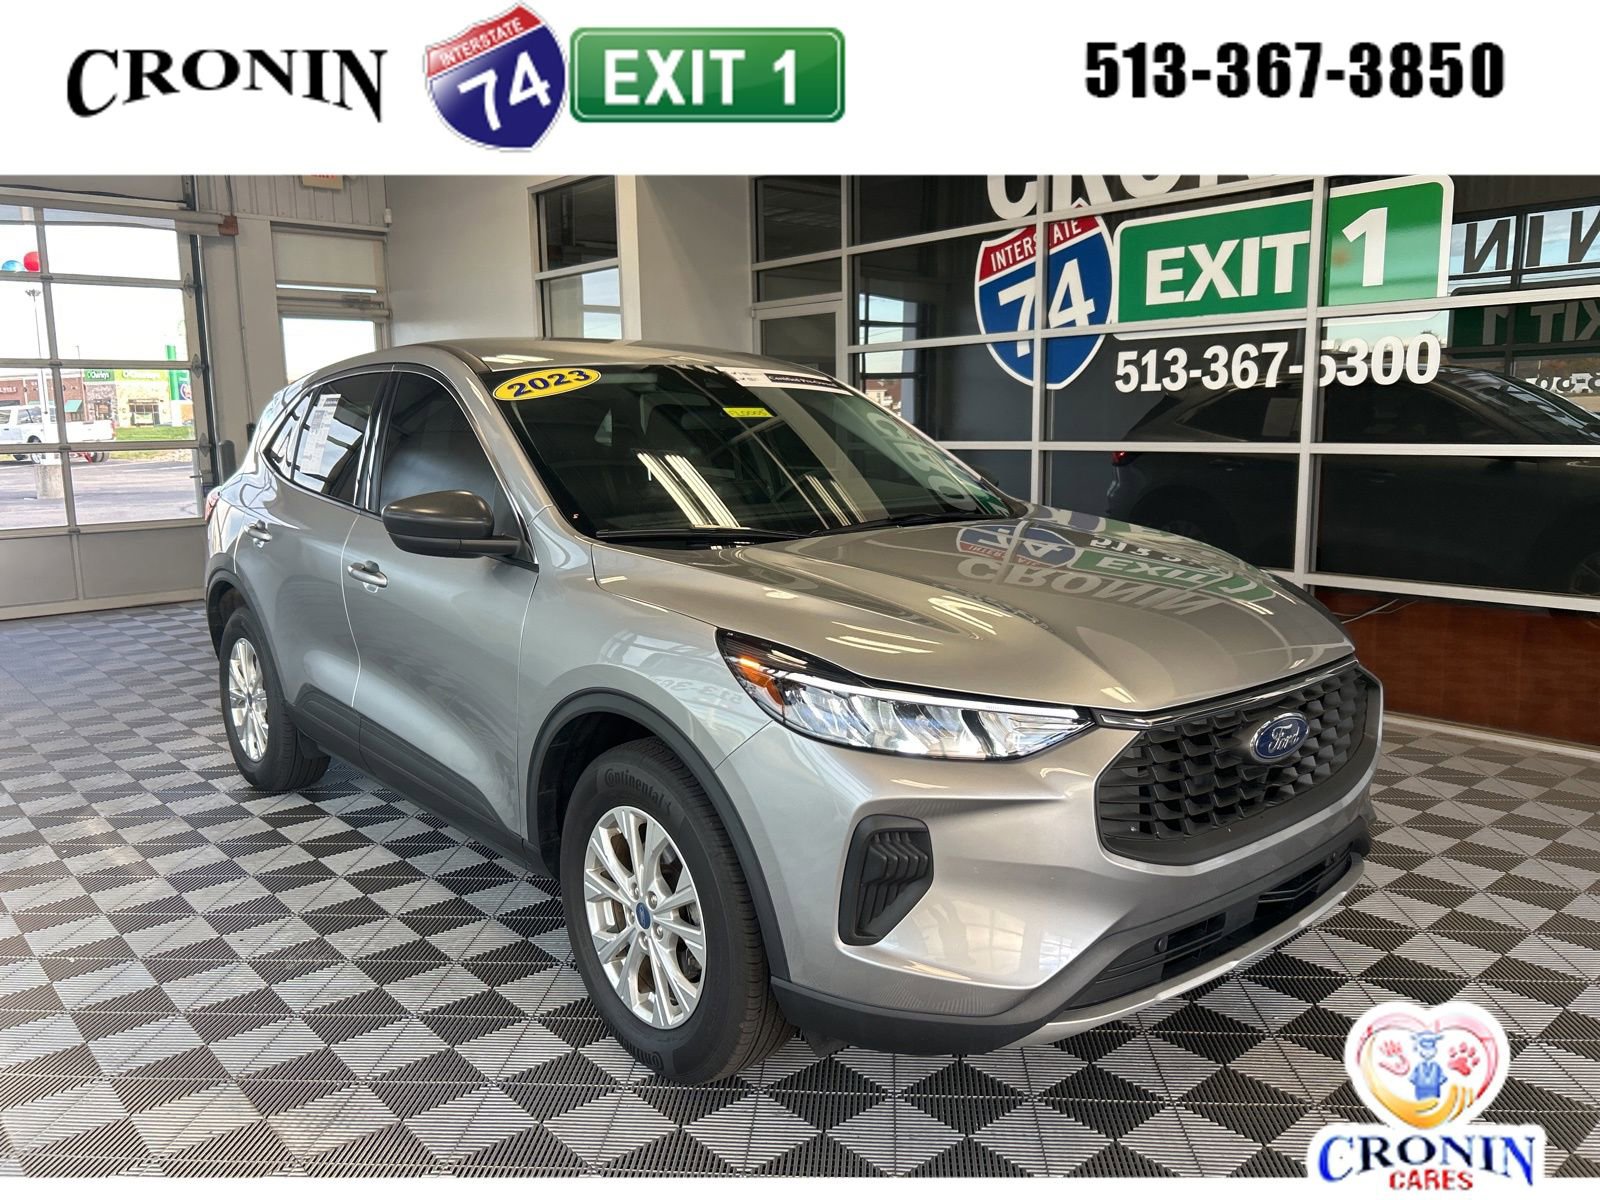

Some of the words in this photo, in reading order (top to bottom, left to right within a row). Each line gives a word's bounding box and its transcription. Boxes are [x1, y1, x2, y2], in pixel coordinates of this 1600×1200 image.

[1146, 230, 1310, 306] EXIT
[1342, 207, 1388, 287] 1
[998, 258, 1096, 358] 74
[507, 370, 590, 398] 2023
[1268, 723, 1300, 754] Ford
[605, 768, 665, 809] Continental
